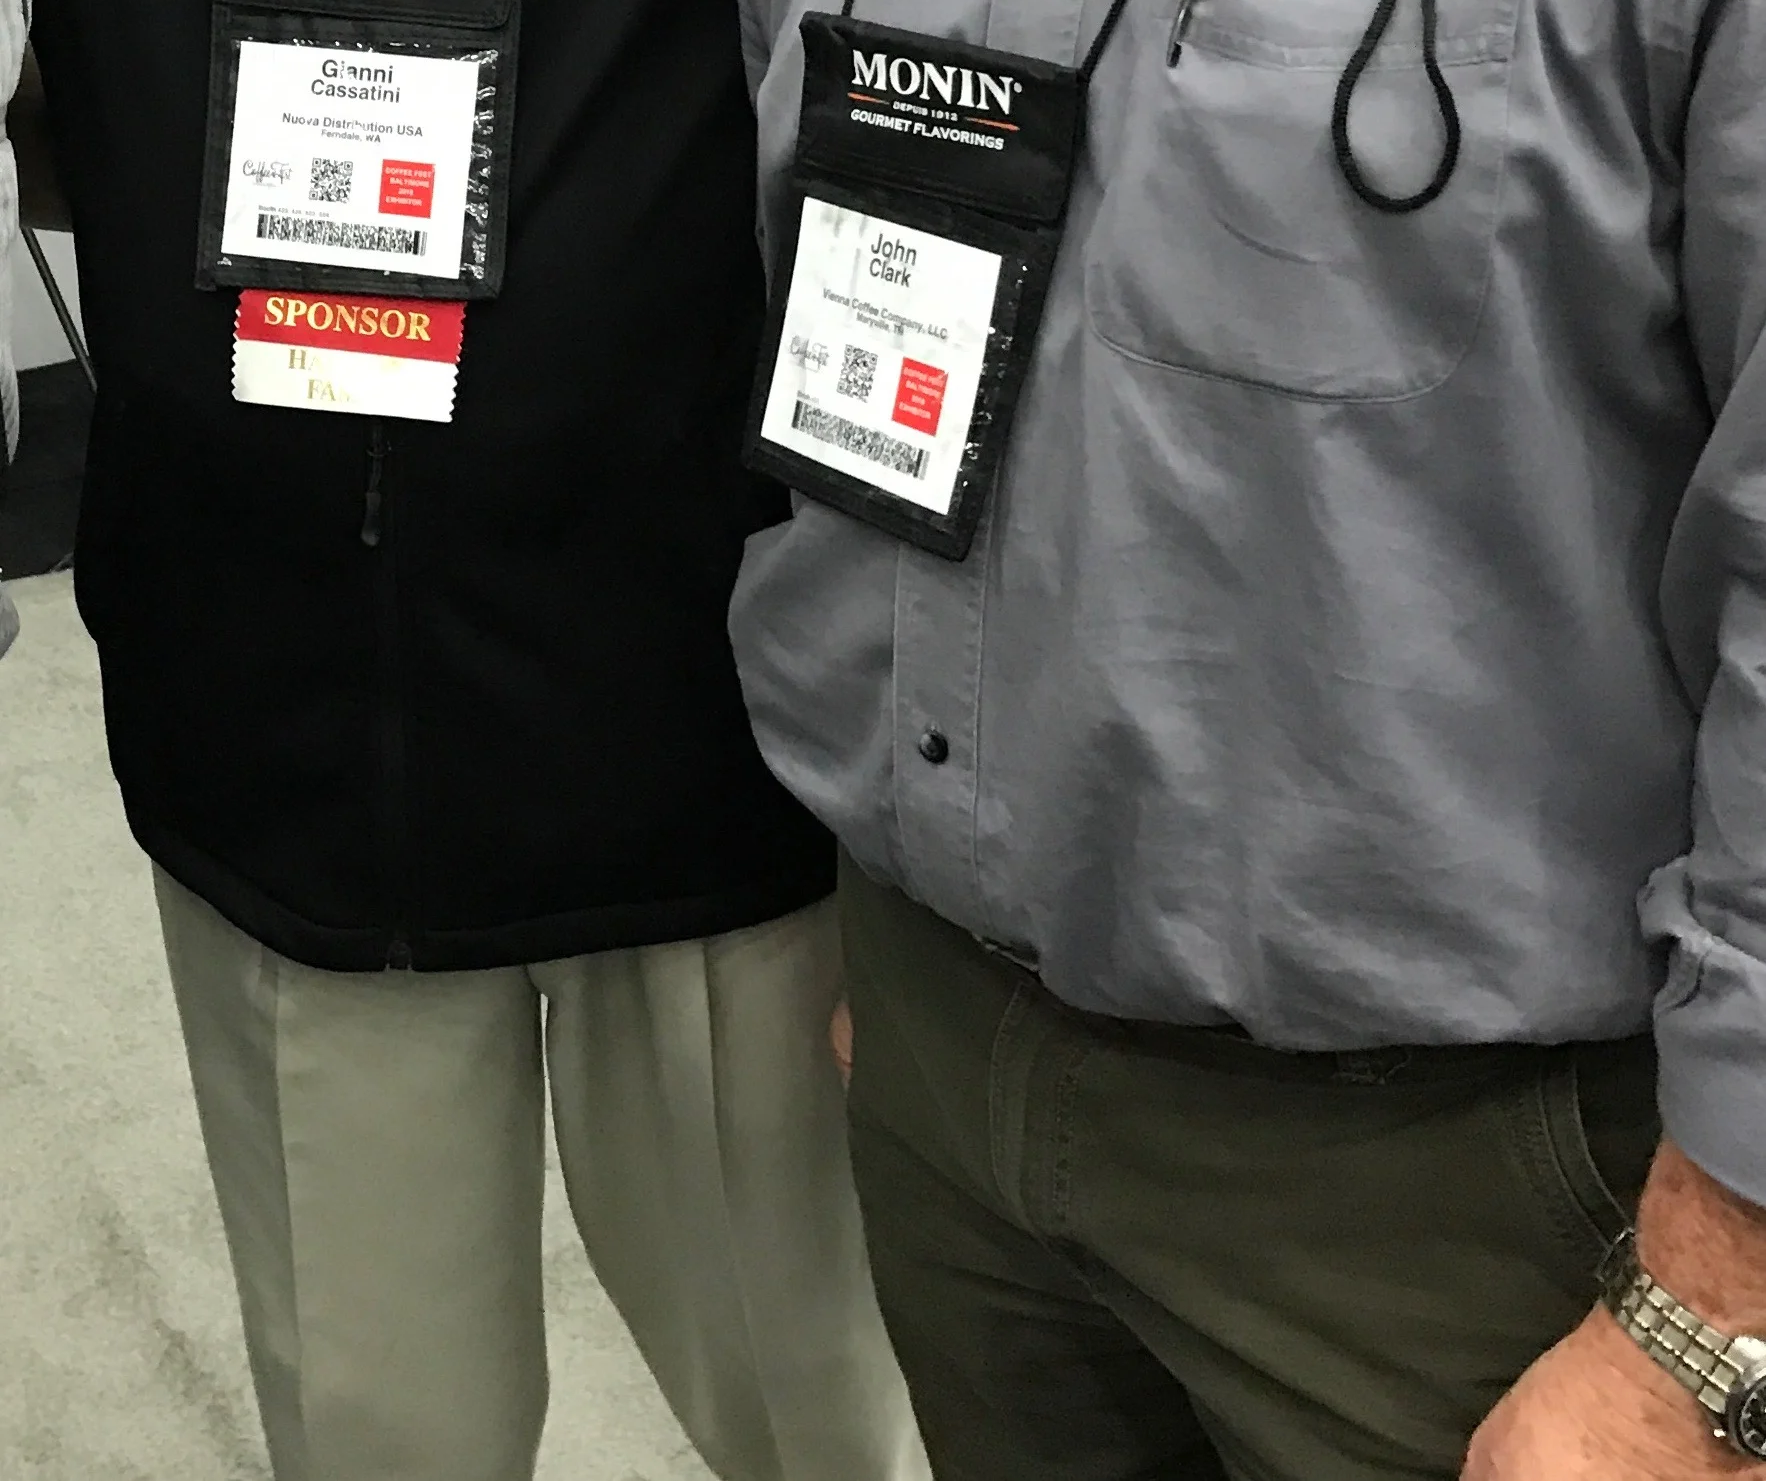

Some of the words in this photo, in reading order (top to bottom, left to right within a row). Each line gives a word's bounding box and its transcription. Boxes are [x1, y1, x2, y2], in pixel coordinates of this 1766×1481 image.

[321, 59, 394, 84] Gianni
[310, 78, 401, 103] Cassatini
[282, 112, 320, 127] Nuova
[396, 124, 423, 137] USA
[850, 108, 912, 133] GOURMET
[913, 122, 1005, 151] FLAVORINGS
[365, 134, 381, 143] WA
[870, 232, 917, 267] John
[869, 258, 912, 288] Clark
[264, 296, 432, 342] SPONSOR
[927, 323, 948, 340] LLC
